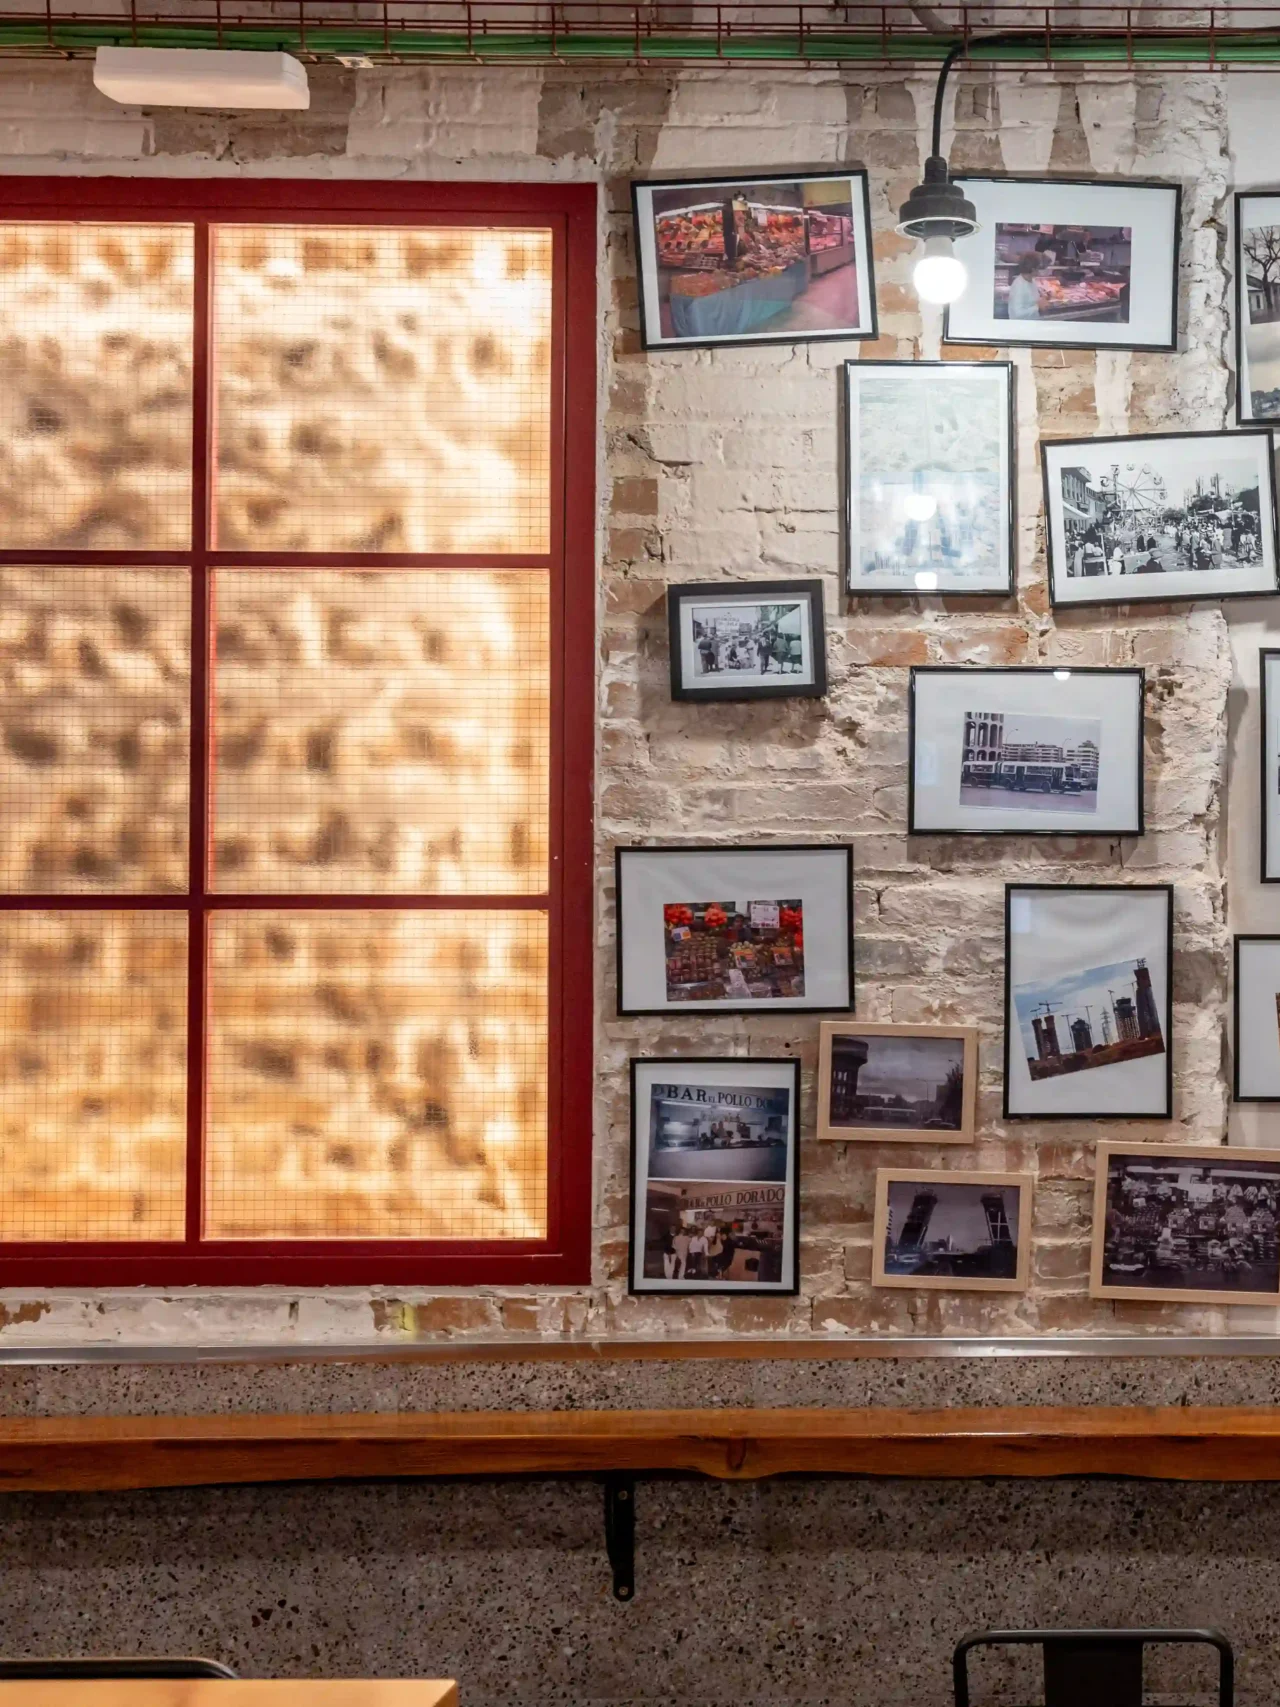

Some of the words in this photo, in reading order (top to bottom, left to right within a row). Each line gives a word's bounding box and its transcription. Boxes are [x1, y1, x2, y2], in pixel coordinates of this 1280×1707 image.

[666, 1085, 707, 1103] BAR
[718, 1092, 752, 1107] POLLO
[706, 1194, 731, 1207] POLLO
[736, 1188, 785, 1205] DORADO
